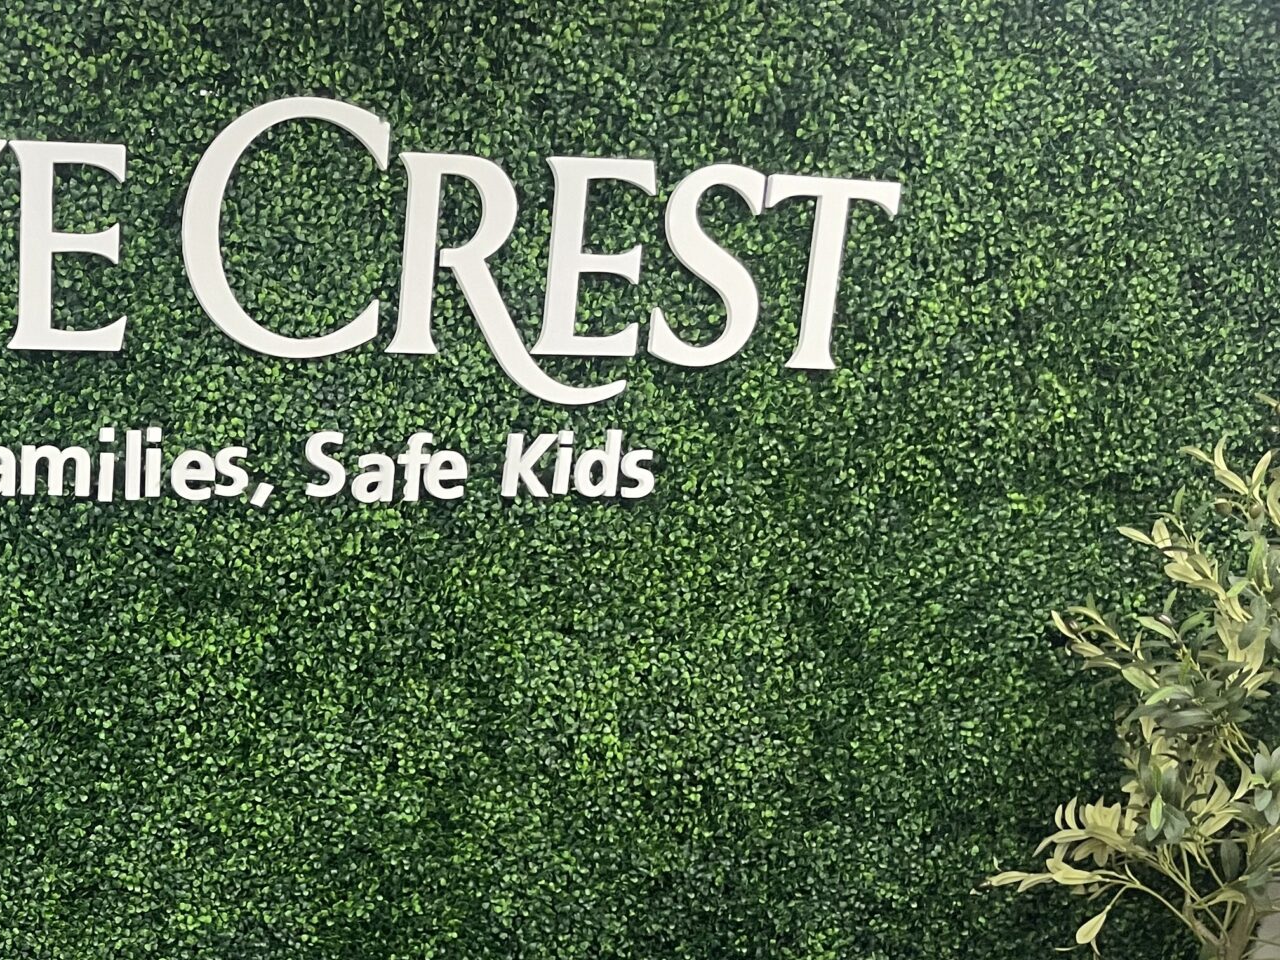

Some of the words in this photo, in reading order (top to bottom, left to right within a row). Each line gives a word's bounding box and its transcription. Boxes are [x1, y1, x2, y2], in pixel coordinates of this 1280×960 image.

[180, 96, 906, 405] CREST
[305, 428, 468, 503] Safe
[499, 428, 656, 500] Kids
